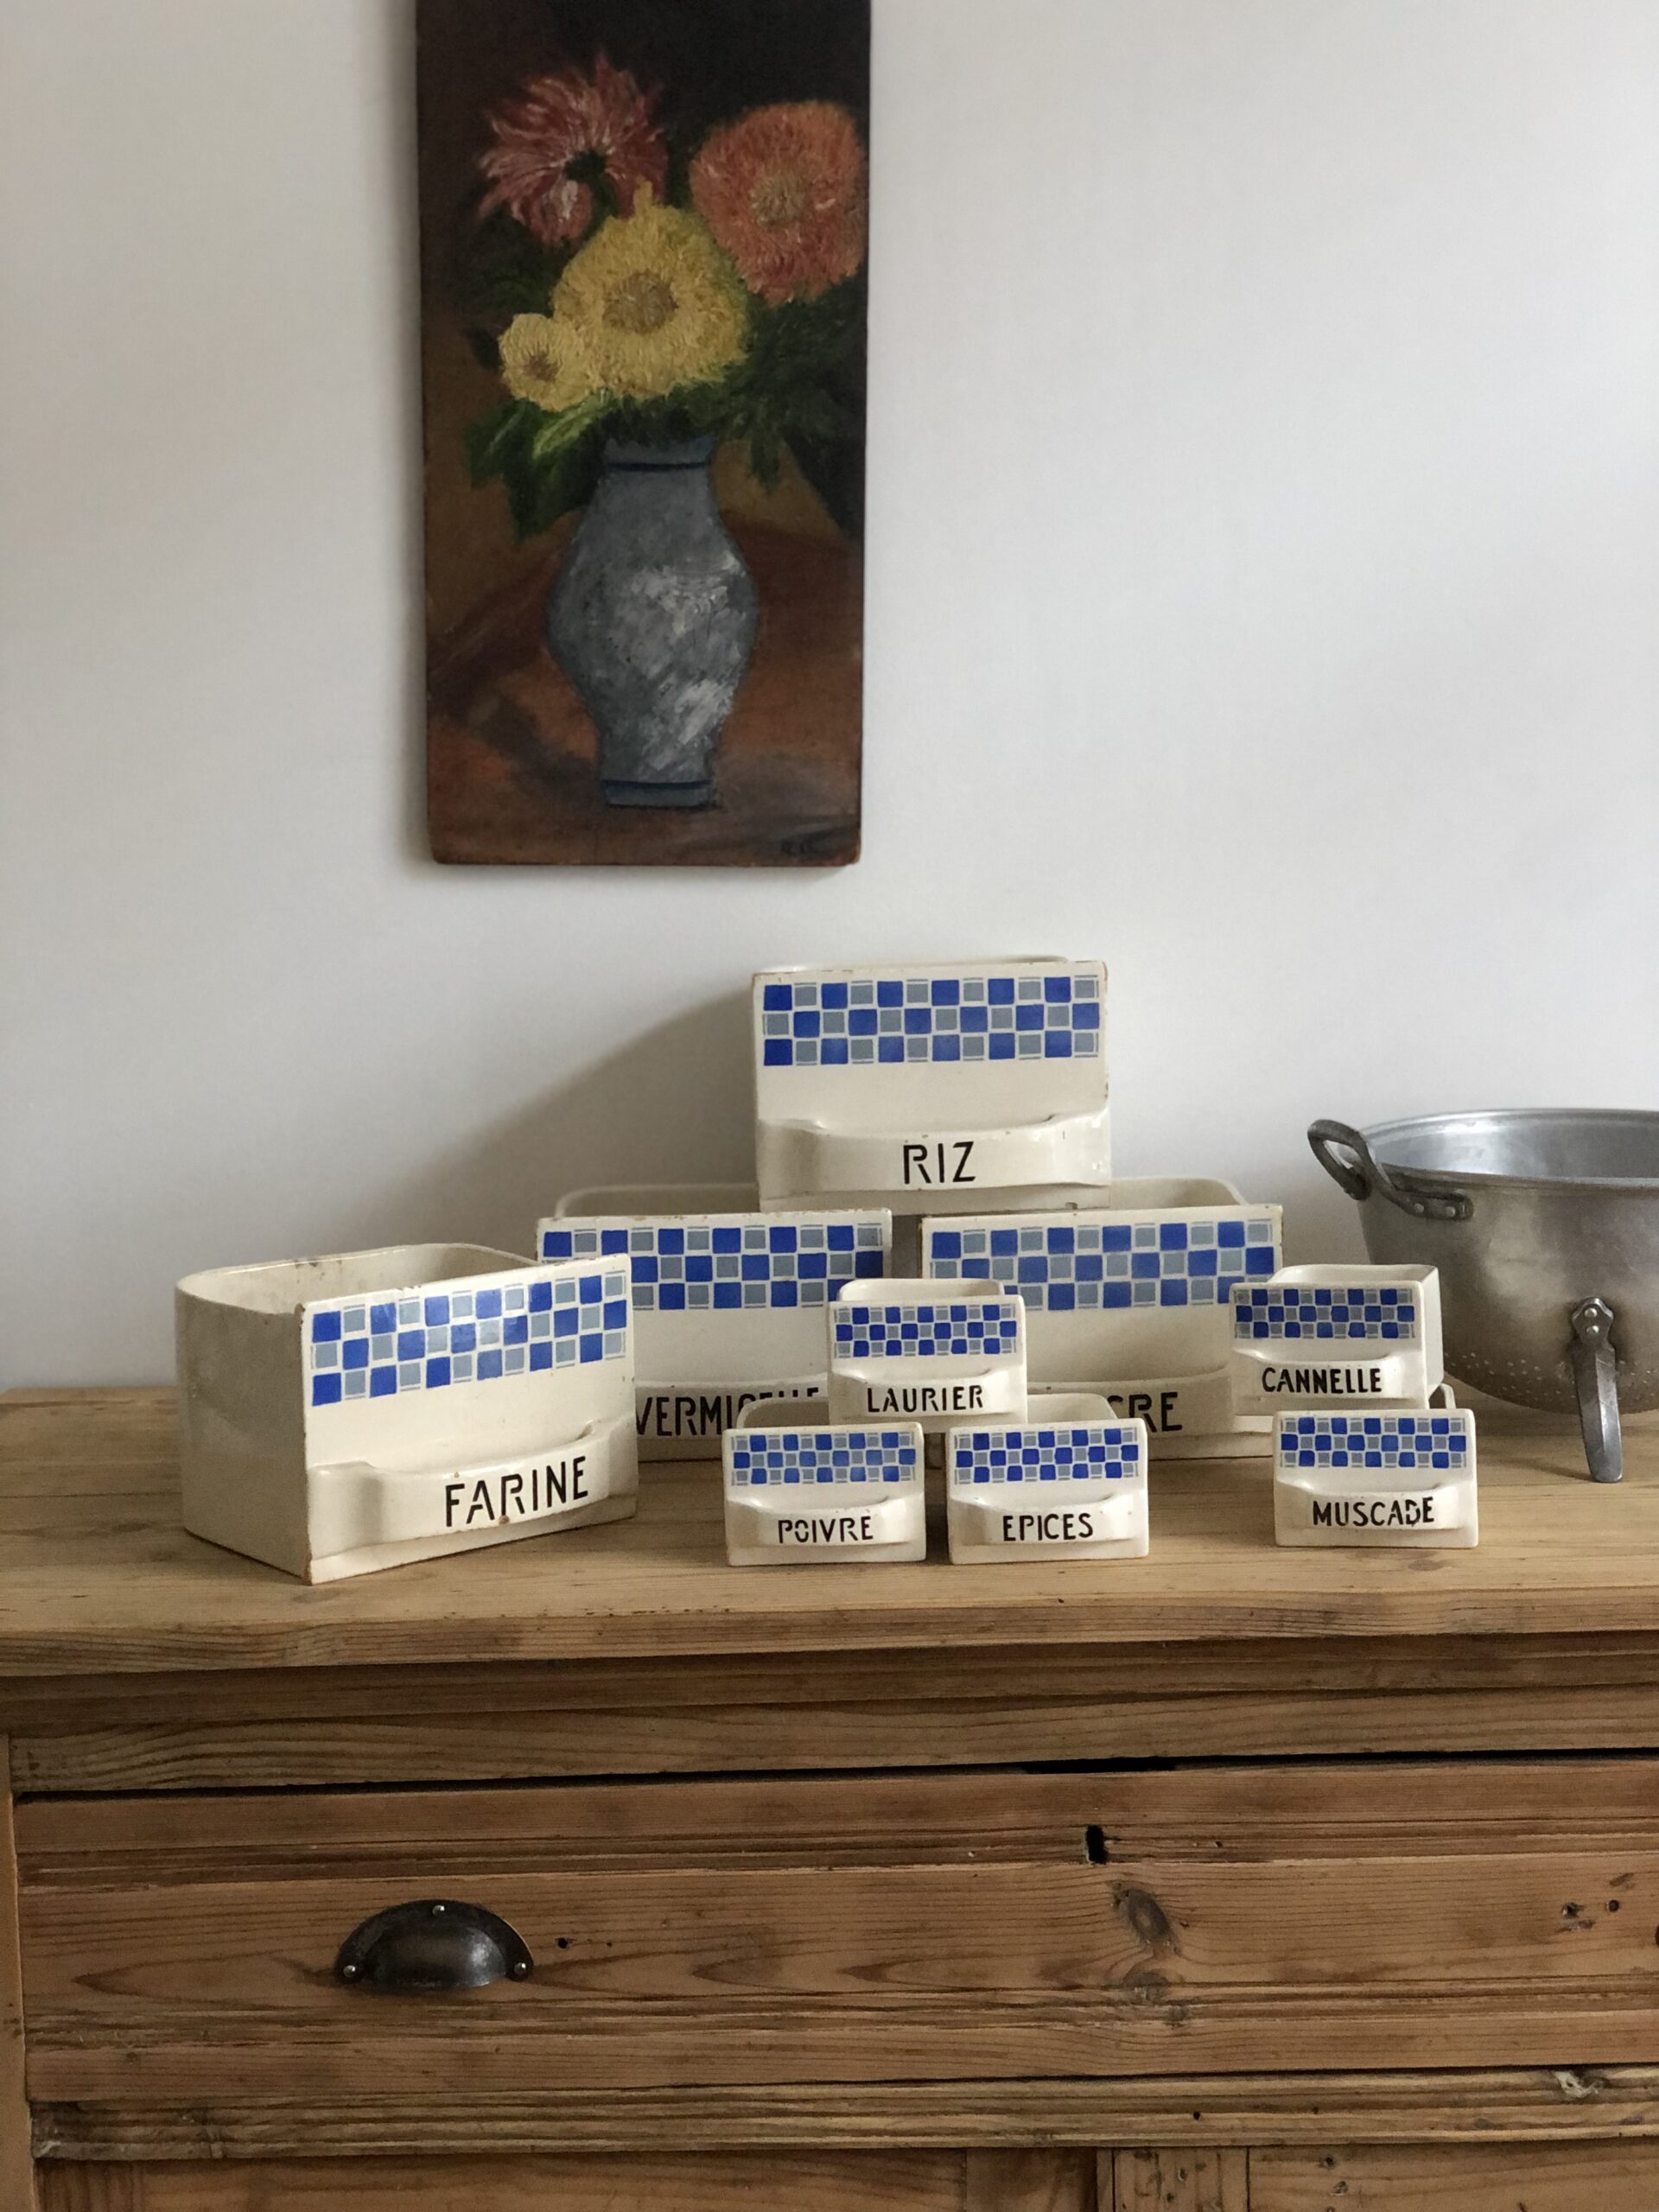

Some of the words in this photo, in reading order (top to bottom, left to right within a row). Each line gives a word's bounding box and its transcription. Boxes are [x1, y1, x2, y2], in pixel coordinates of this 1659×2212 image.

[903, 1141, 976, 1185] RIZ
[1262, 1367, 1382, 1394] CANNELLE
[867, 1385, 983, 1413] LAURIER
[444, 1455, 589, 1528] FARINE
[1002, 1512, 1093, 1542] EPICES
[1313, 1497, 1434, 1527] MUSCADE
[778, 1516, 874, 1544] POIVRE
